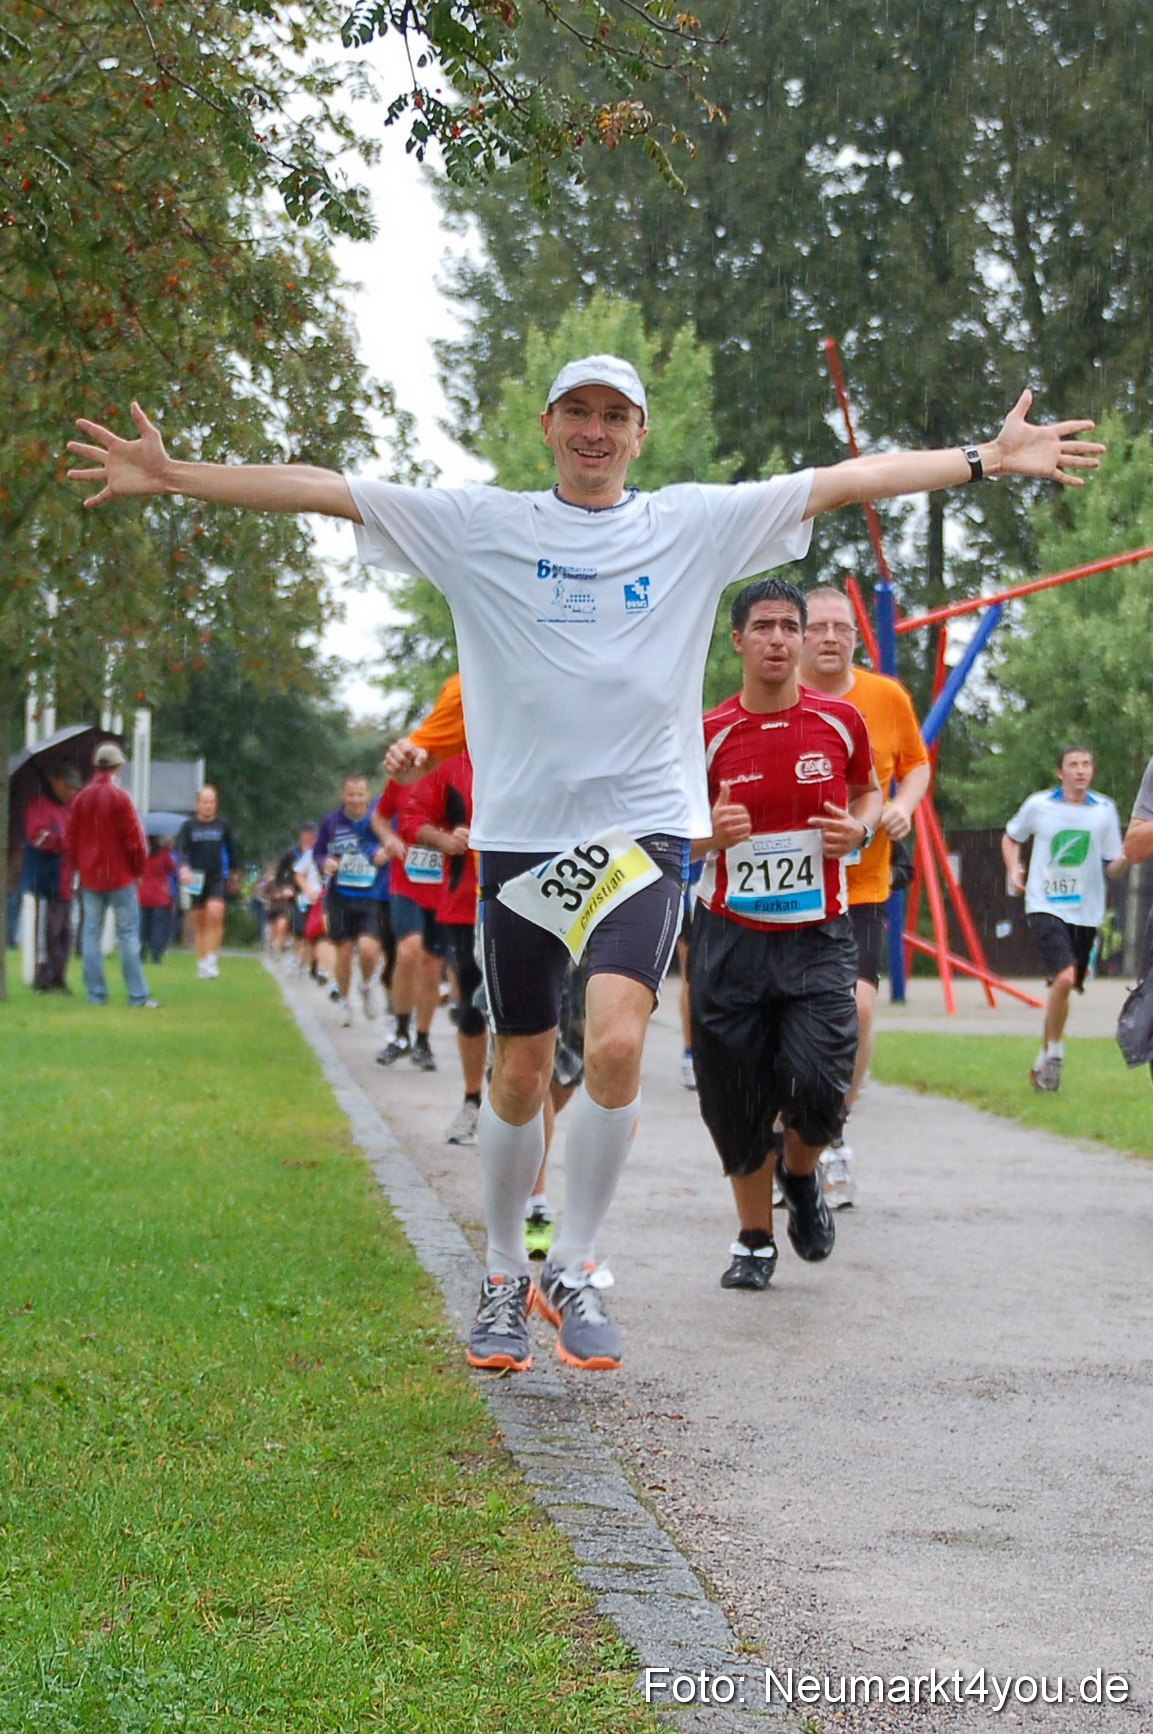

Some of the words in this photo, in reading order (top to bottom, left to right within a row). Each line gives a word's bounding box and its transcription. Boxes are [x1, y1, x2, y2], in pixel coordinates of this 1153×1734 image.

[541, 844, 610, 912] 336
[737, 855, 814, 893] 2124
[580, 869, 626, 930] Christian
[754, 899, 798, 913] Furkan
